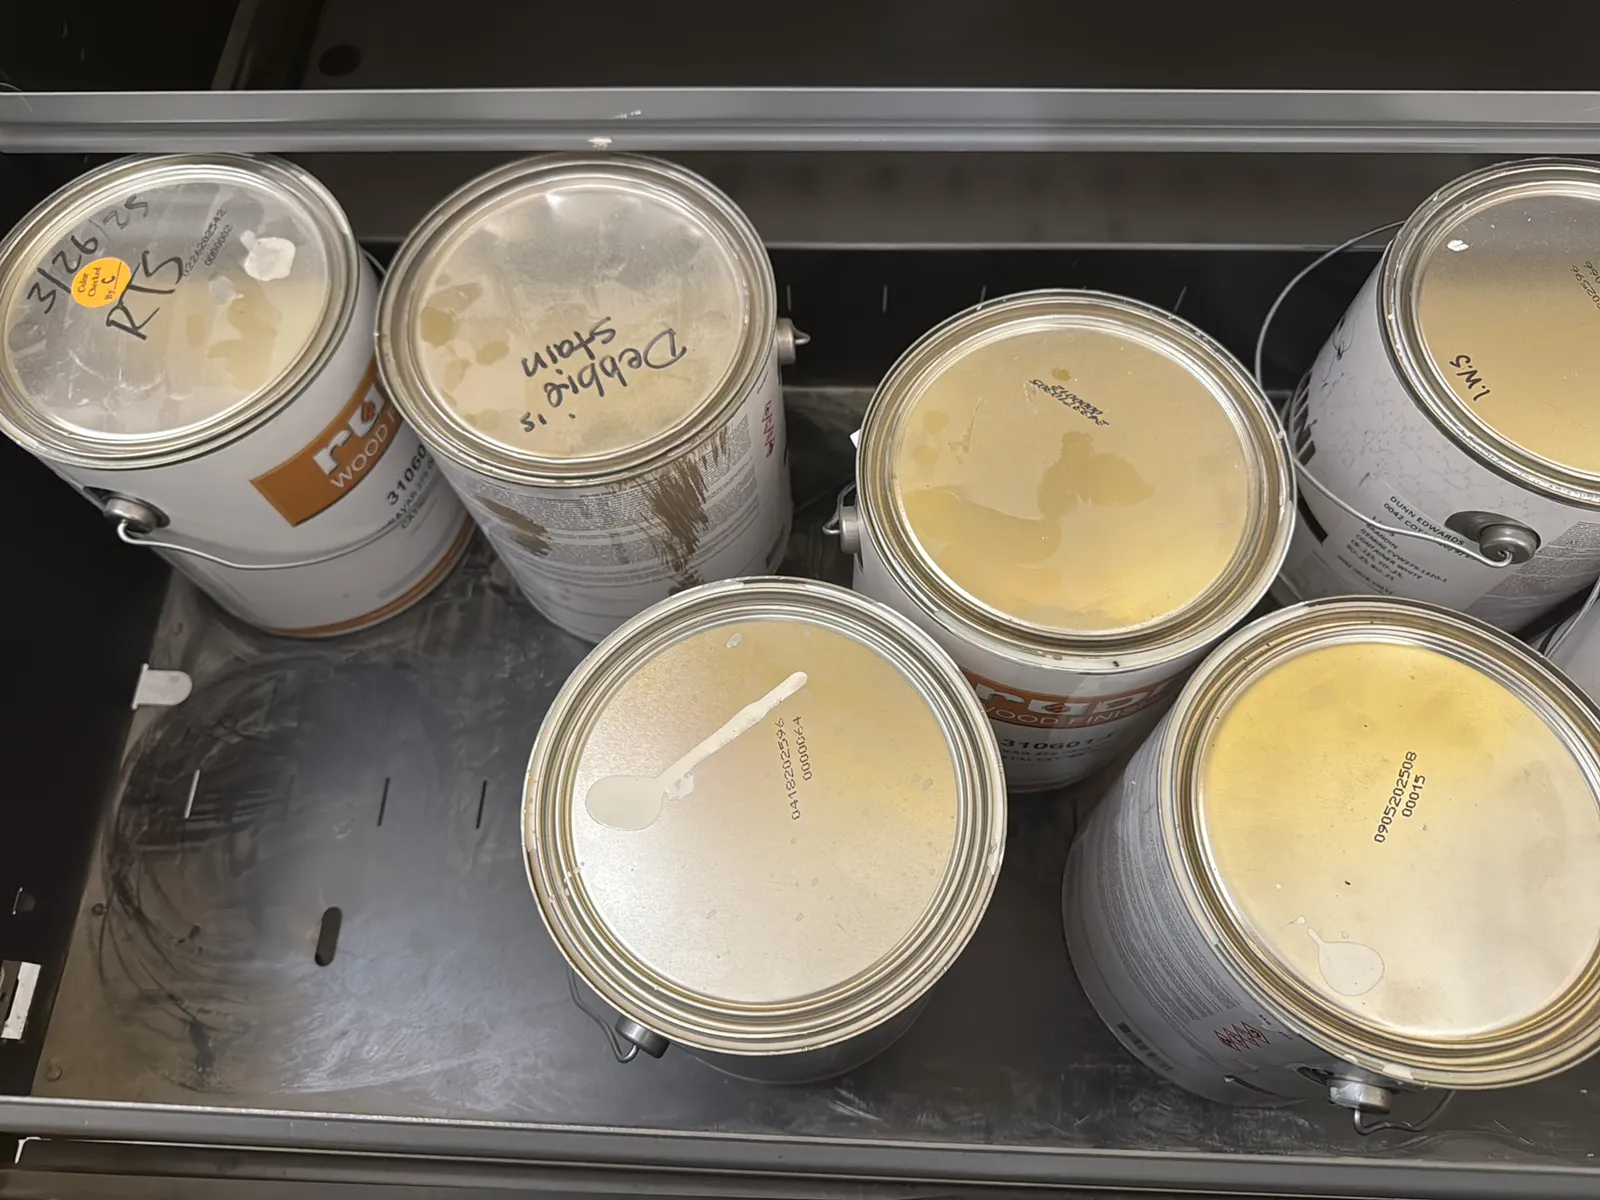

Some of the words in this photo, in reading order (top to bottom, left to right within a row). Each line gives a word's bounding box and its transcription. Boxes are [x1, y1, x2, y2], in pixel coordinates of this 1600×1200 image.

[27, 193, 149, 314] 3/26/25
[77, 272, 89, 293] Color
[87, 266, 102, 297] Checked
[104, 289, 116, 301] By
[106, 250, 184, 341] RTS
[521, 316, 616, 378] stain
[520, 328, 687, 433] Debbie's
[330, 423, 388, 488] WOOD
[1383, 502, 1404, 521] 0042
[1389, 495, 1416, 519] DUNN
[1416, 516, 1465, 546] EDWARDS
[774, 717, 801, 821] 0418202596
[792, 715, 813, 781] 0000064
[1373, 750, 1418, 843] 0905202508
[1401, 774, 1426, 818] 00015
